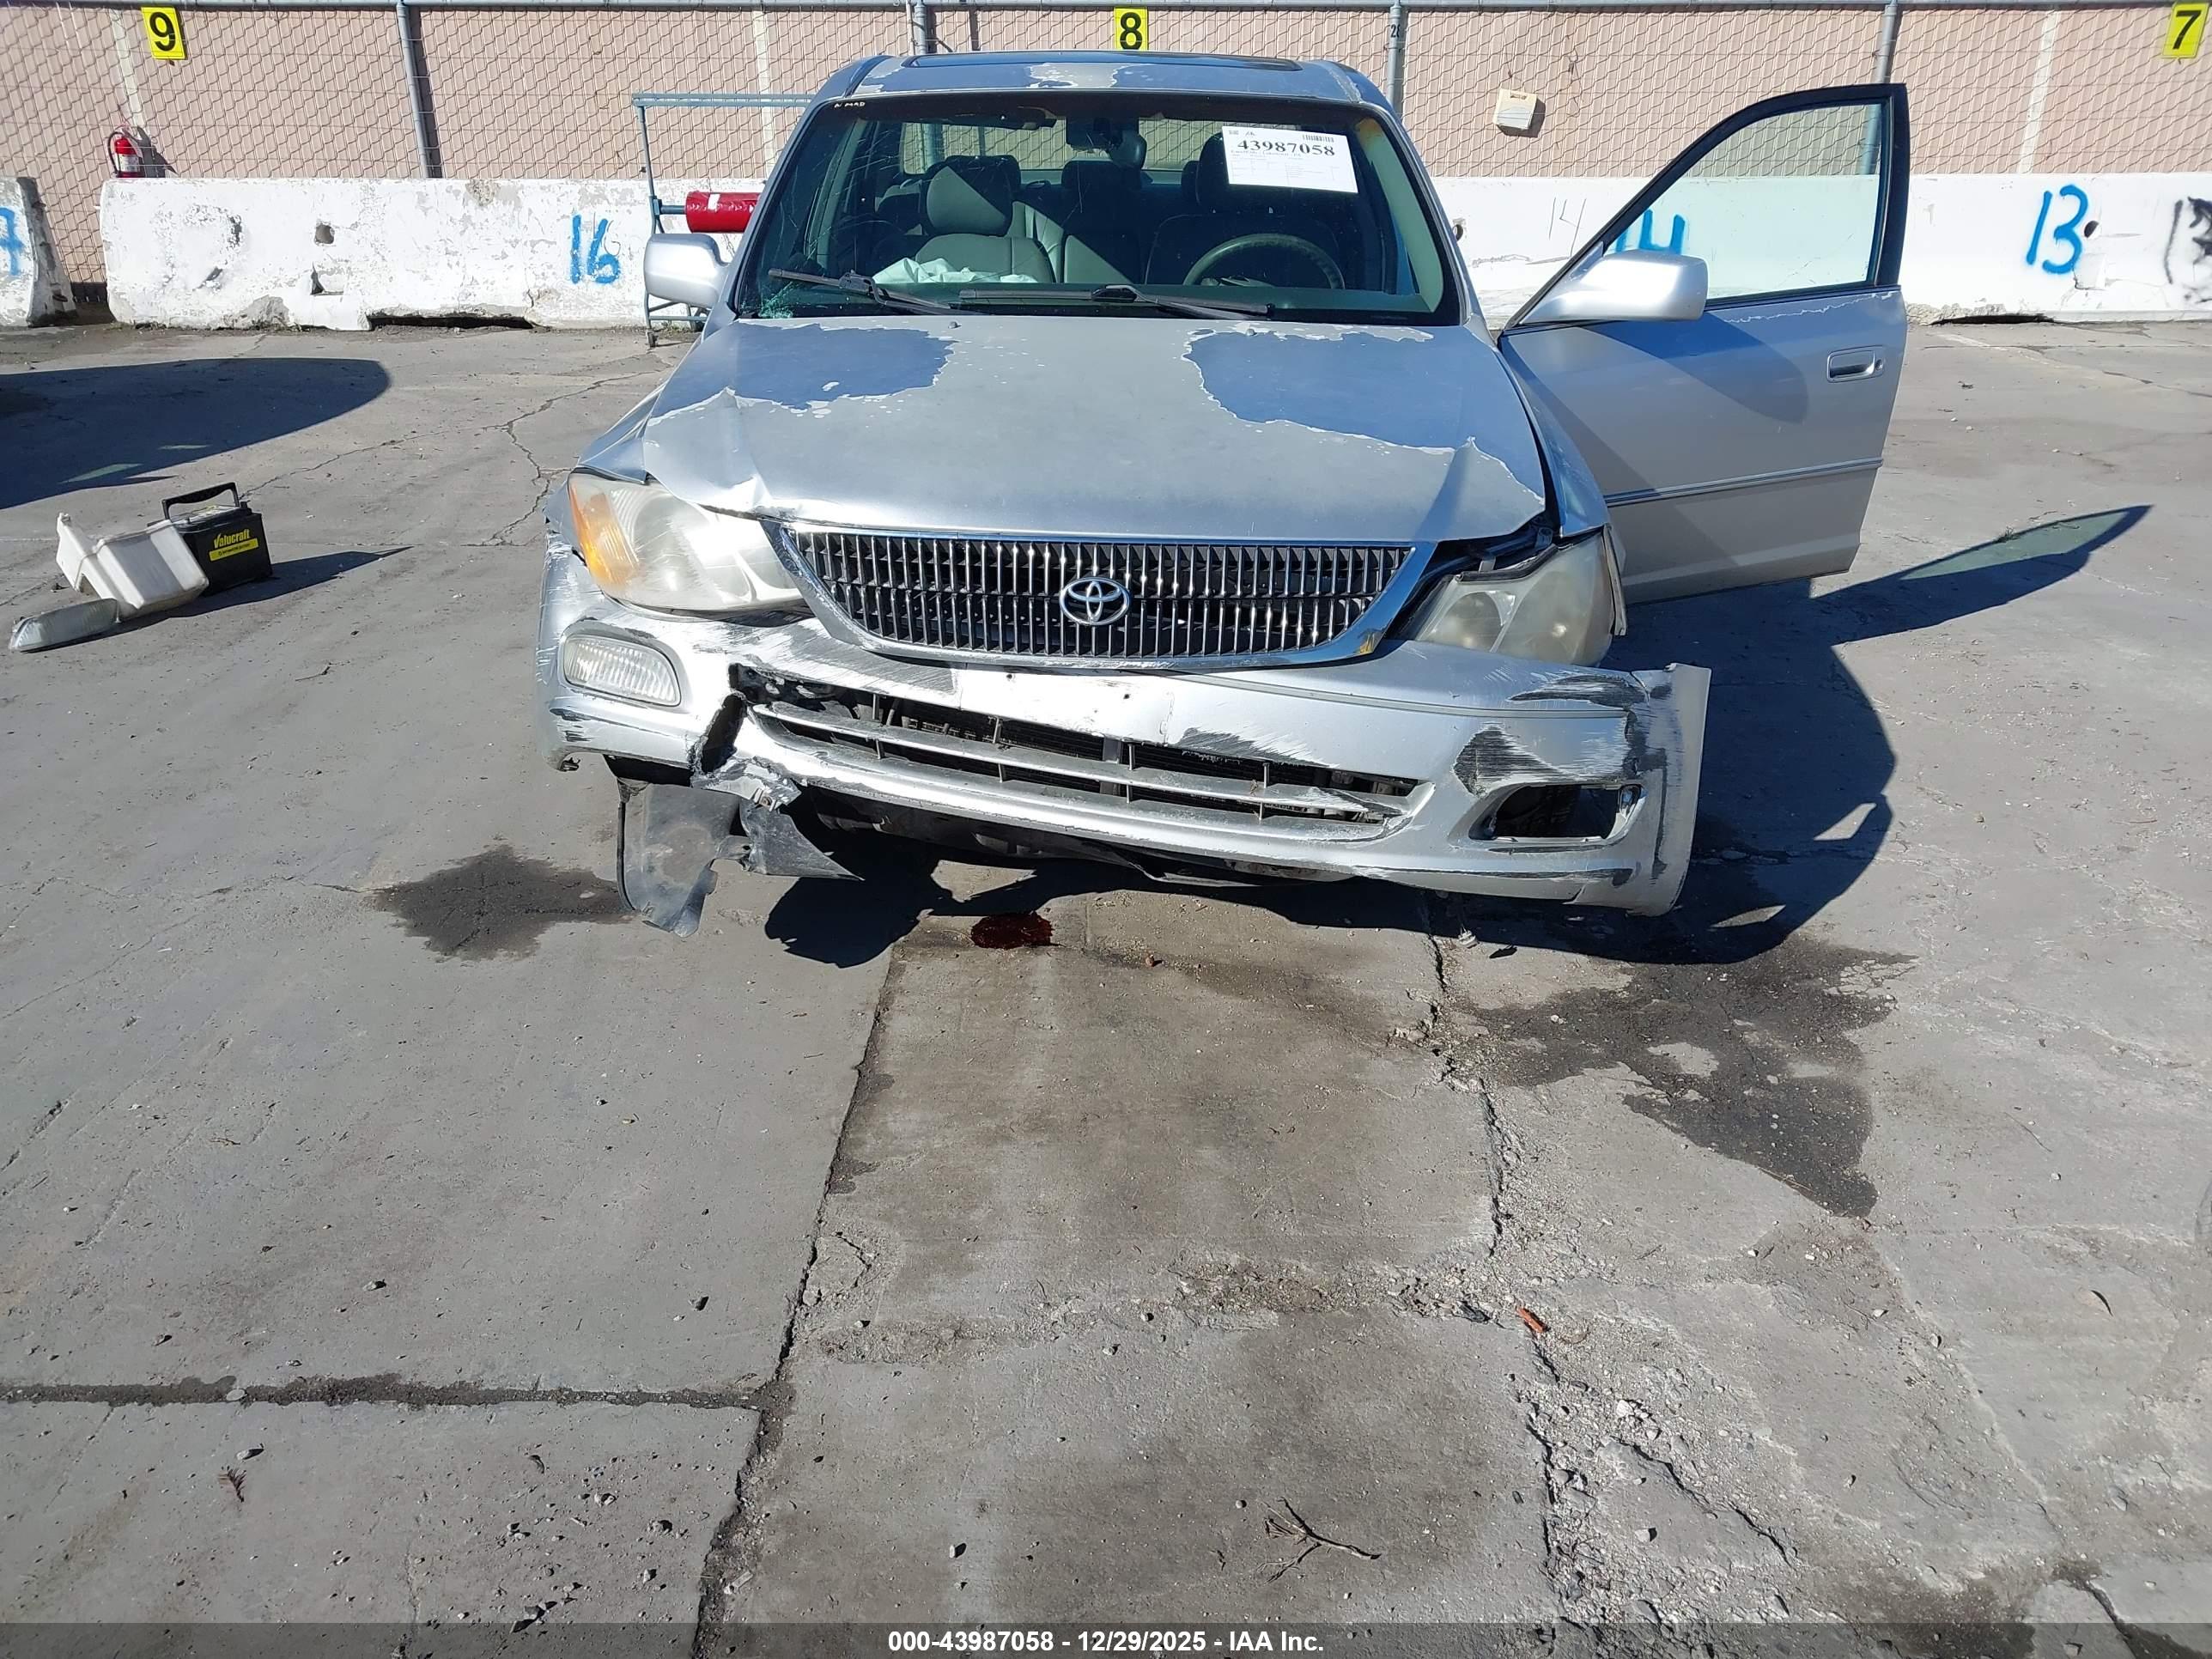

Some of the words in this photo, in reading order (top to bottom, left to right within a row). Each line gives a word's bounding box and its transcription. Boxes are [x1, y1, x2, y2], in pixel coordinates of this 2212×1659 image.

[149, 11, 176, 52] 9
[1120, 11, 1143, 50] 8
[2172, 9, 2203, 50] 7
[1237, 140, 1335, 156] 43987058
[1547, 197, 1587, 258] 14
[2025, 184, 2089, 276] 13
[570, 215, 621, 284] 16
[213, 528, 250, 549] Valucraft
